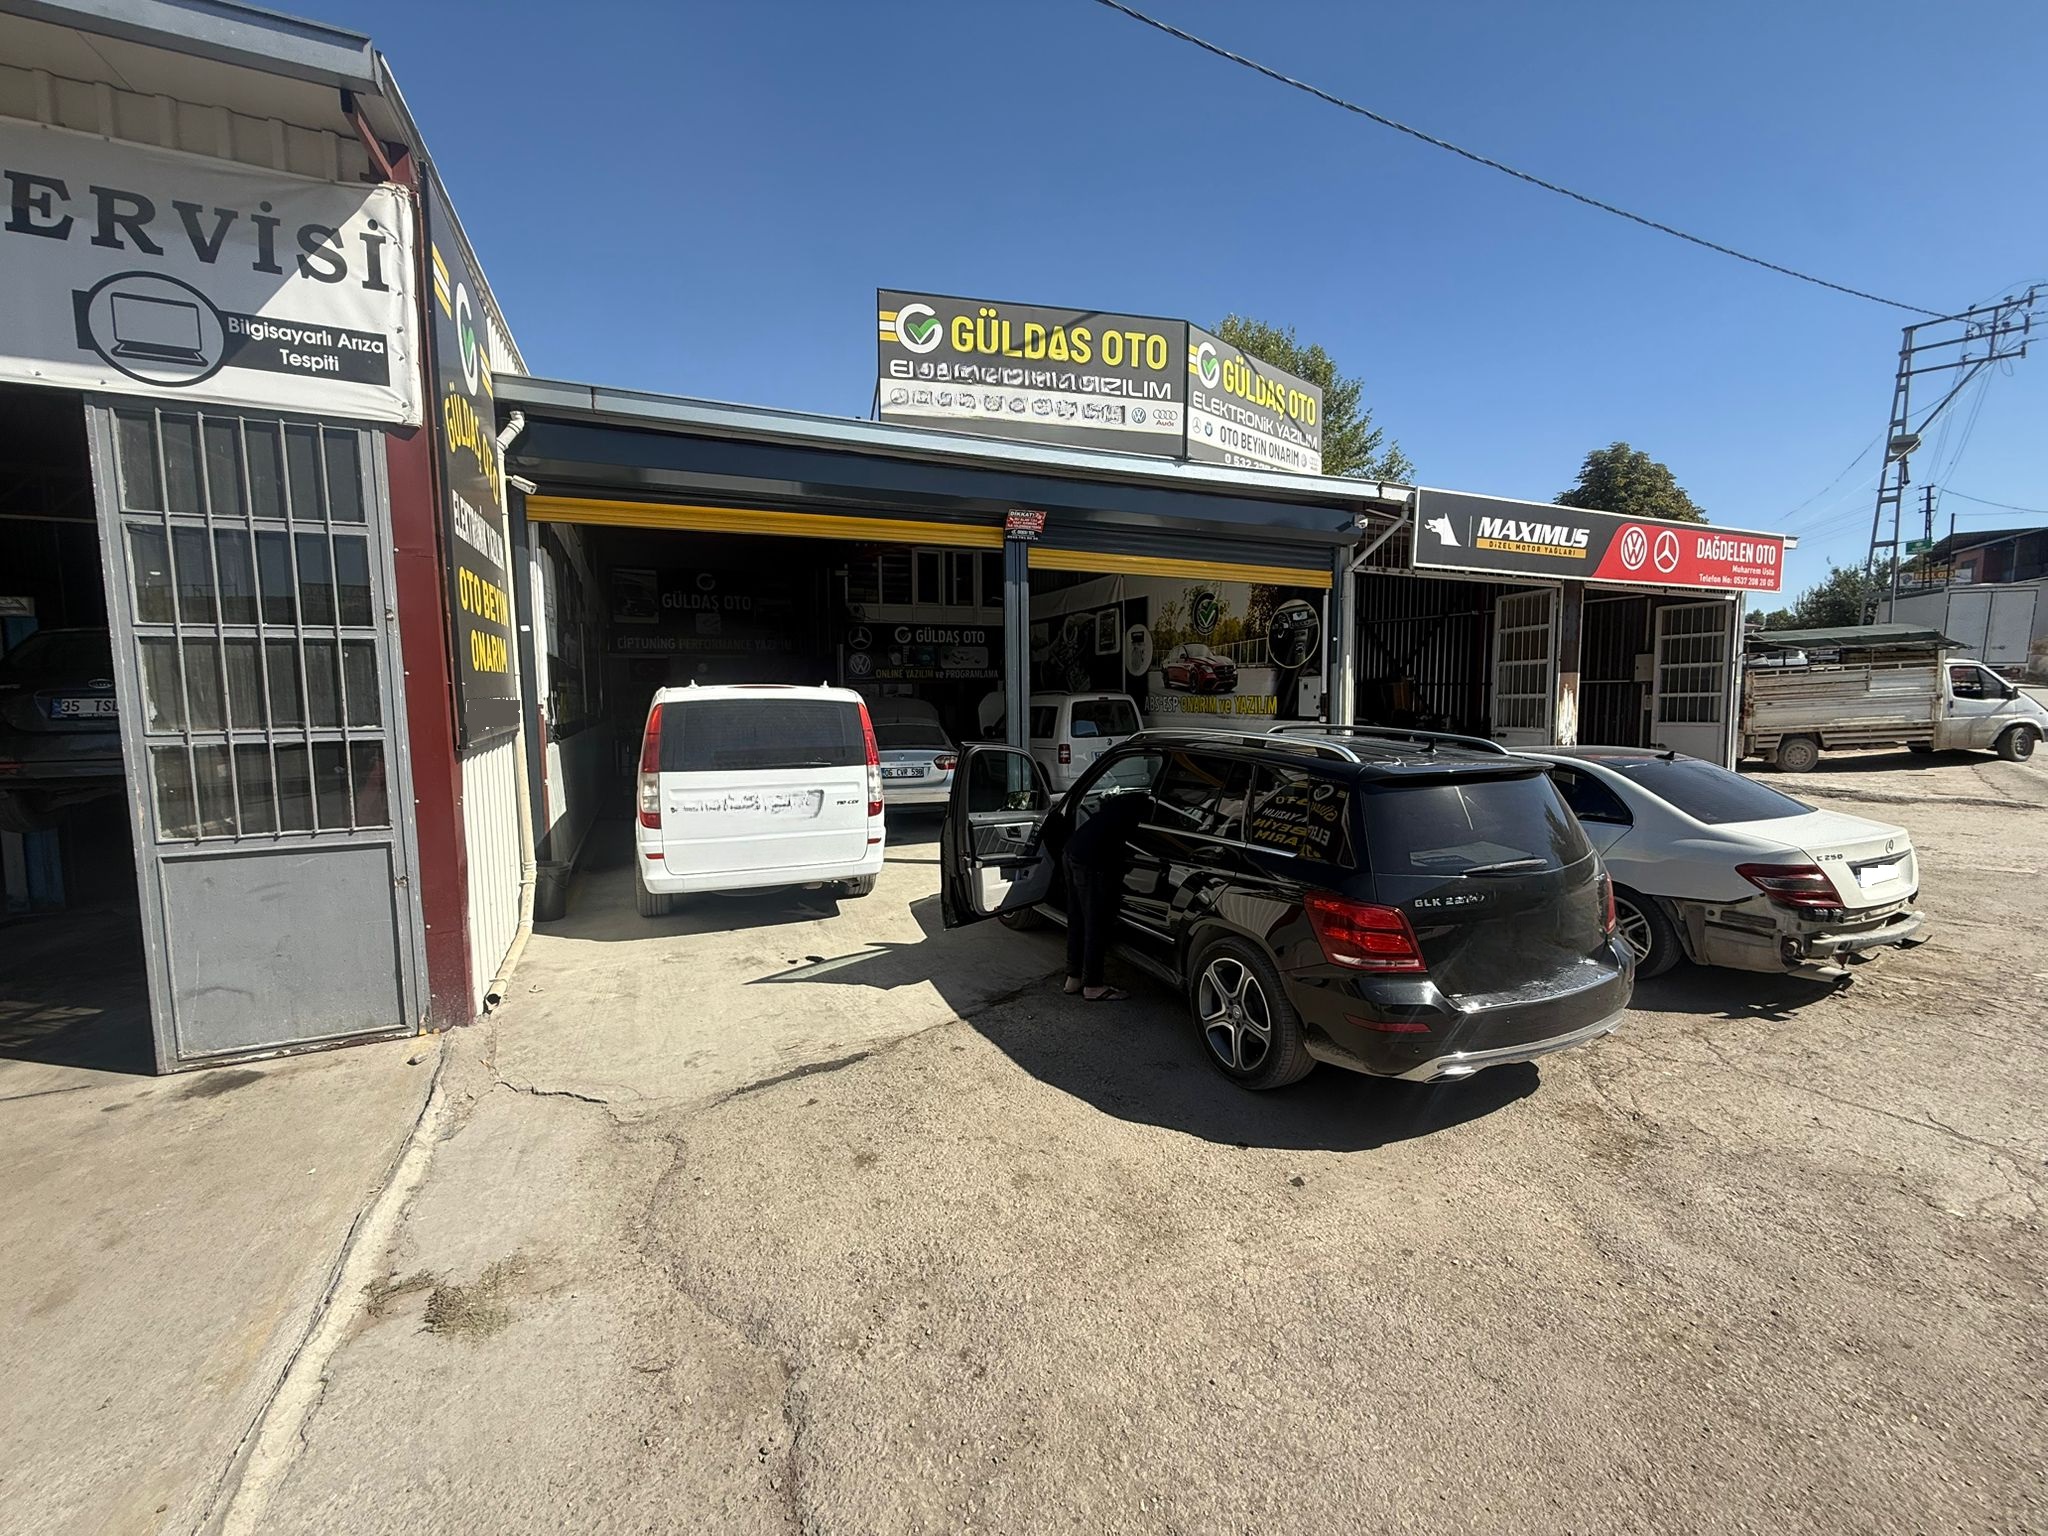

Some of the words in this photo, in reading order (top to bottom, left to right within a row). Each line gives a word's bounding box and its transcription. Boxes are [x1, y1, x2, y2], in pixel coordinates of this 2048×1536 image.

[228, 317, 333, 347] Bilgisayarlı
[338, 332, 385, 354] Arıza
[279, 348, 340, 373] Tespiti
[1102, 330, 1167, 370] OTO
[1223, 355, 1286, 420] GÜLDAŞ
[1289, 389, 1317, 426] OTO
[1193, 391, 1278, 434] ELEKTRONİK
[1276, 422, 1318, 450] YAZILIM
[1220, 425, 1239, 447] OTO
[1241, 432, 1267, 456] BEYİN
[1268, 442, 1300, 467] ONARIM
[483, 433, 499, 505] OTO
[1477, 516, 1590, 548] MAXIMUS
[1489, 541, 1512, 549] DİZEL
[1515, 543, 1541, 552] MOTOR
[1545, 546, 1576, 556] YAĞLARI
[1696, 535, 1754, 563] DAĞDELEN
[1756, 544, 1776, 565] OTO
[1699, 573, 1721, 583] Telefon
[1722, 576, 1732, 584] No:
[1732, 565, 1761, 574] Muharrem
[1762, 567, 1775, 576] Usta
[459, 566, 482, 616] OTO
[661, 590, 719, 613] GÜLDAŞ
[723, 595, 752, 611] OTO
[915, 627, 960, 646] GÜLDAŞ
[963, 631, 985, 644] OTO
[471, 629, 508, 674] ONARIM
[935, 670, 945, 679] ve
[62, 700, 80, 712] 35
[1180, 696, 1217, 714] ONARIM
[1218, 698, 1231, 714] ve
[1234, 695, 1278, 715] YAZILIM
[1414, 898, 1442, 908] GLK
